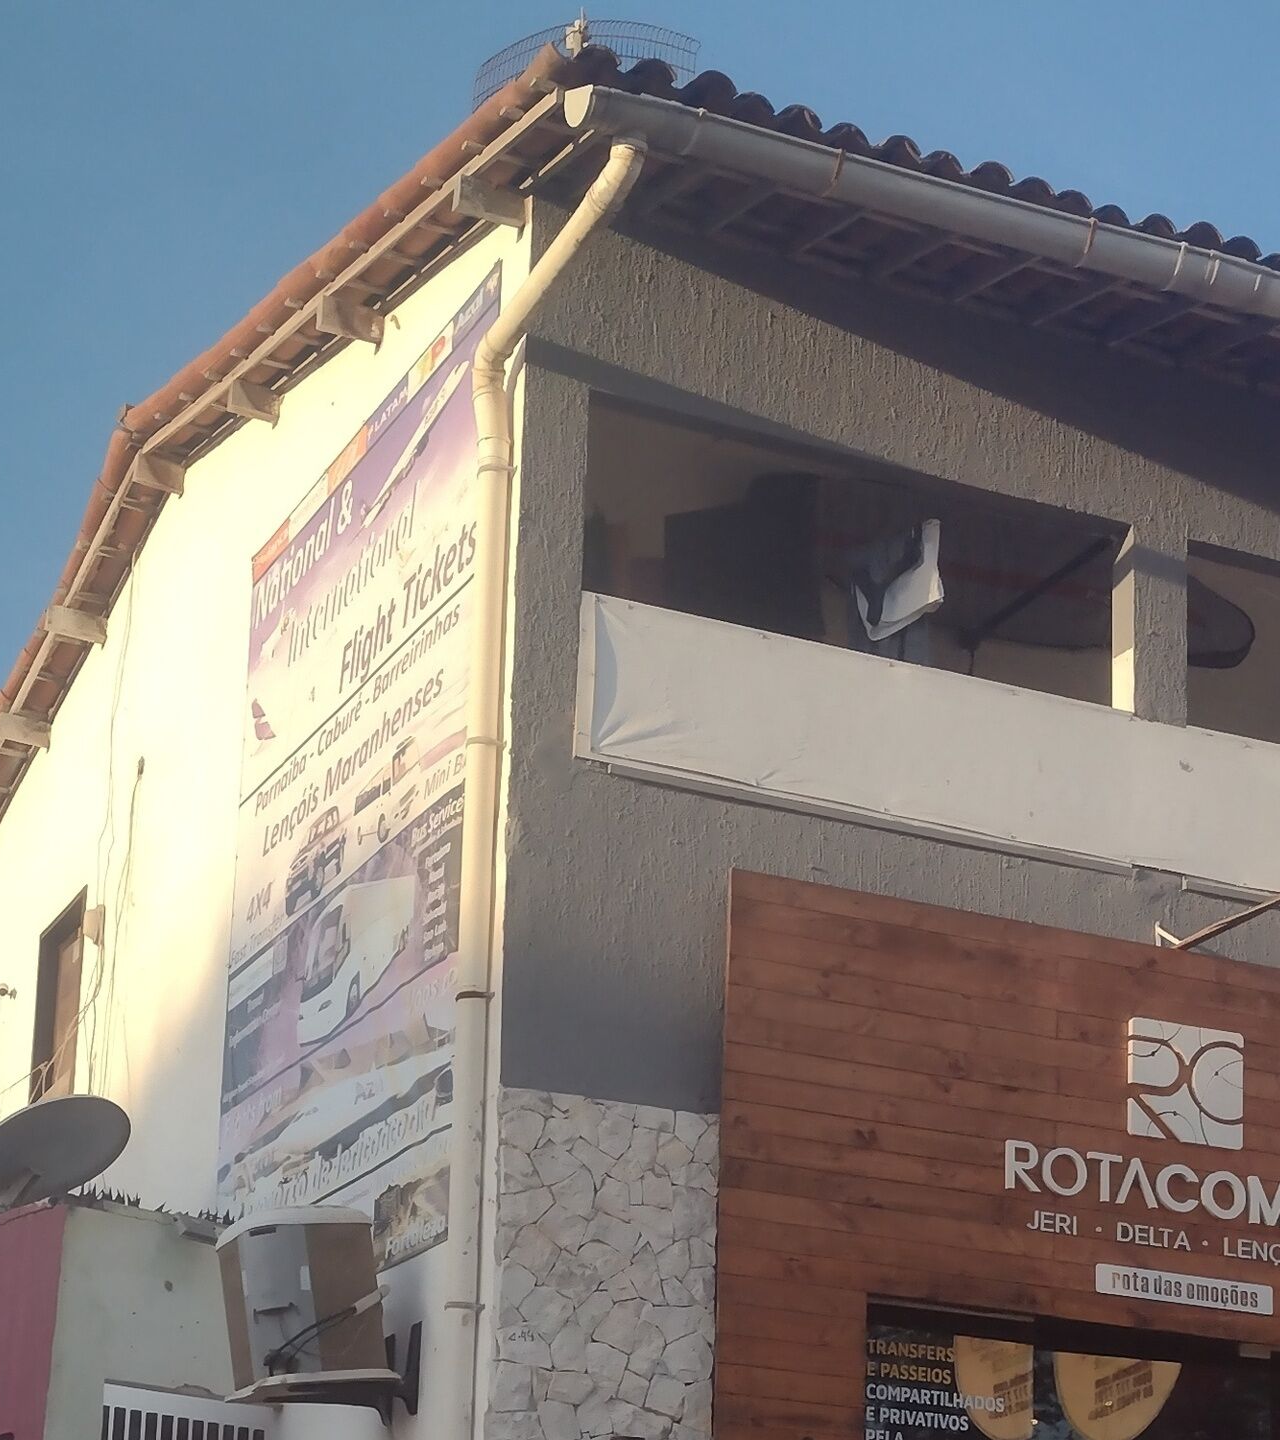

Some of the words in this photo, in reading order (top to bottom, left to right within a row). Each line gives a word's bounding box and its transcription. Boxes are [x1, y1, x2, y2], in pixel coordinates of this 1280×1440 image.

[253, 497, 335, 631] National
[336, 479, 354, 536] &
[287, 480, 419, 668] International
[339, 596, 396, 695] Flight
[402, 520, 477, 628] Tickets
[371, 602, 461, 705] Barreirinhas
[261, 782, 320, 859] Lençóis
[323, 665, 445, 802] Maranhenses
[423, 759, 451, 801] Mini
[1026, 1209, 1079, 1237] JERI
[1116, 1221, 1192, 1253] DELTA
[1111, 1270, 1150, 1295] rota
[1153, 1274, 1183, 1299] das
[1186, 1284, 1259, 1309] emoções
[866, 1339, 954, 1362] TRANSFERS
[866, 1361, 875, 1377] E
[880, 1363, 952, 1385] PASSEIOS
[865, 1406, 875, 1422] E
[879, 1407, 969, 1431] PRIVATIVOS
[866, 1383, 1005, 1413] COMPARTILHADOS
